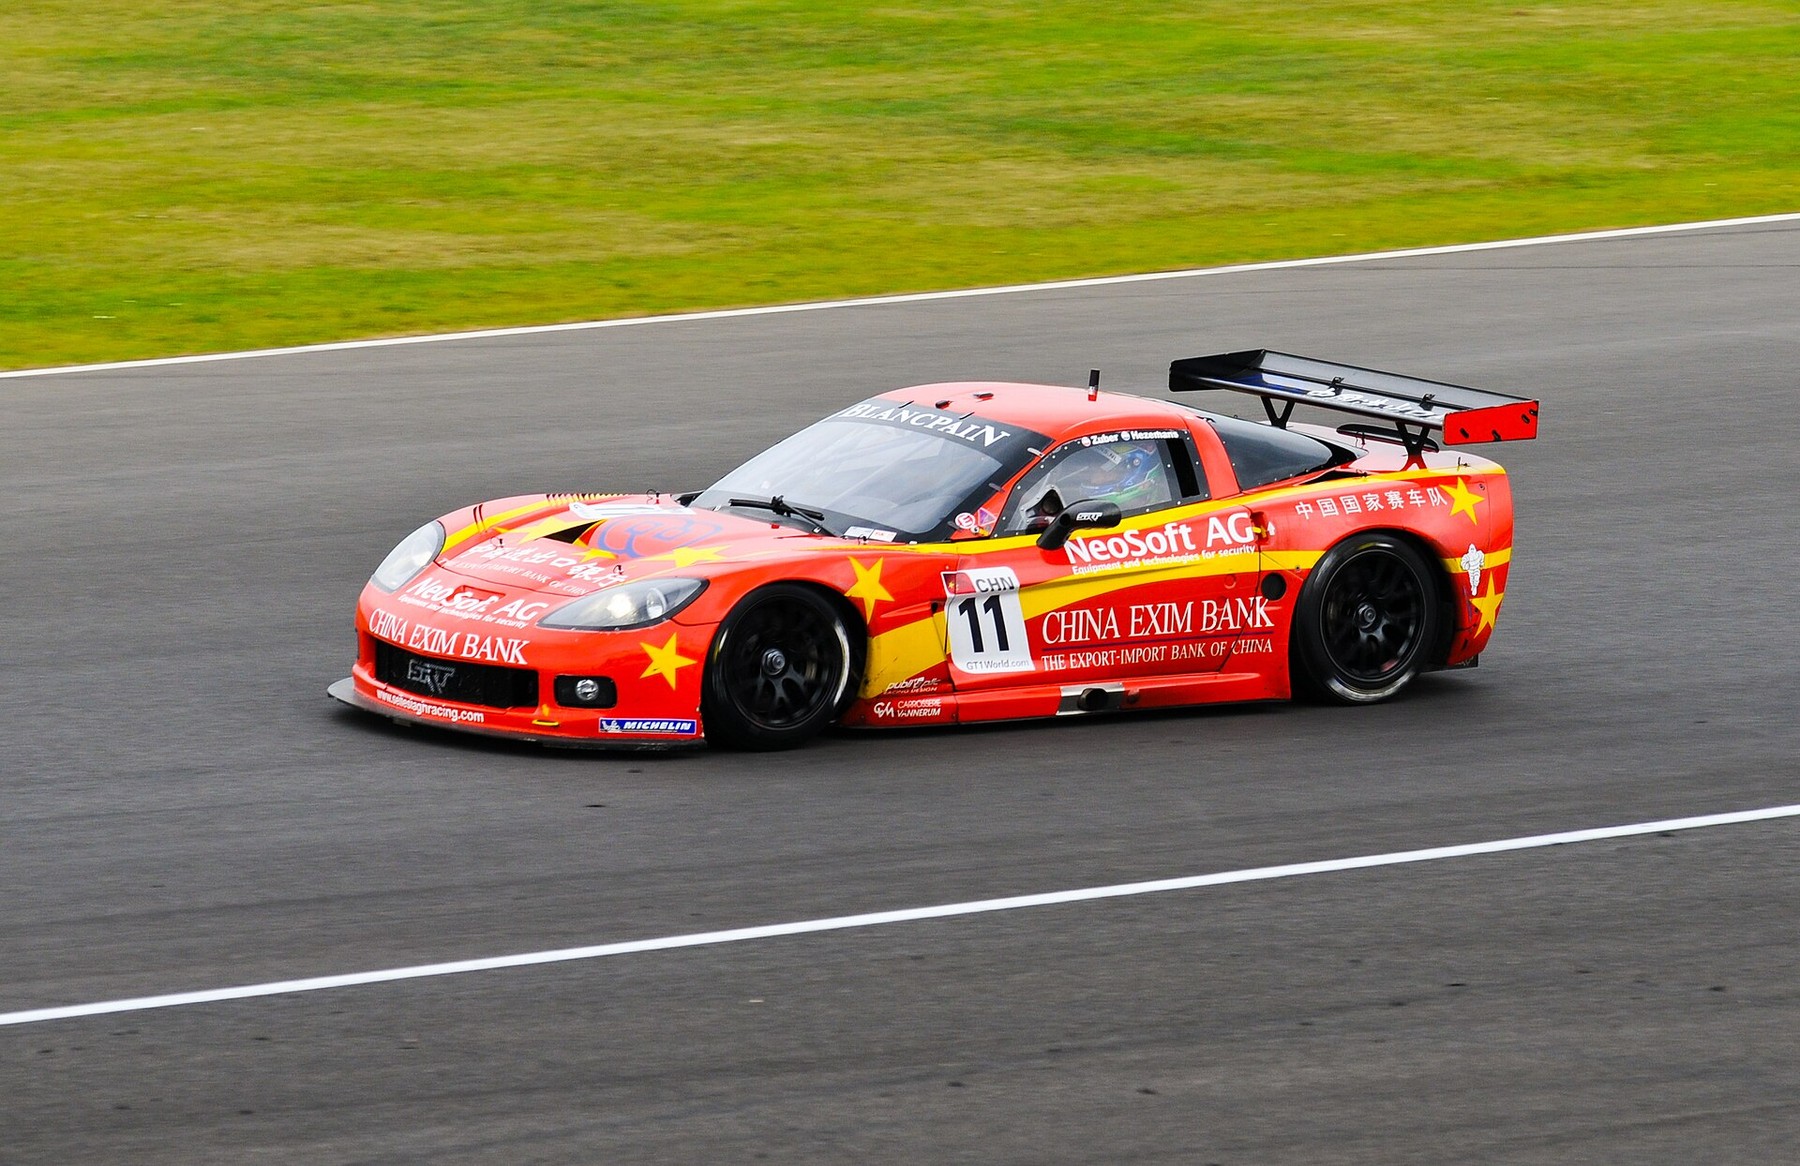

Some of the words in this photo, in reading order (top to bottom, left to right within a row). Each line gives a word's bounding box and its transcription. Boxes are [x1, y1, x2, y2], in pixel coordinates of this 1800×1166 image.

[838, 403, 1010, 447] BLANCPAIN
[1090, 433, 1119, 445] Zuber
[1130, 430, 1179, 440] Hezemans
[1294, 487, 1448, 520] 中国国家赛车队
[1063, 521, 1196, 565] NeoSoft
[1206, 512, 1256, 548] AG
[1072, 561, 1121, 576] Equipment
[1124, 558, 1141, 568] and
[1143, 552, 1200, 568] technologies
[1202, 550, 1216, 561] for
[1218, 544, 1256, 558] security
[975, 577, 1015, 593] CHN
[492, 599, 549, 620] AG
[495, 617, 529, 629] security
[958, 595, 1010, 653] 11
[1042, 606, 1120, 645] CHINA
[1129, 601, 1193, 637] EXIM
[1200, 595, 1274, 632] BANK
[368, 608, 408, 644] CHINA
[409, 623, 460, 656] EXIM
[460, 633, 530, 665] BANK
[966, 659, 1030, 671] GT1World.com
[1041, 653, 1067, 671] THE
[1069, 645, 1167, 668] EXPORT-IMPORT
[1171, 642, 1206, 660] BANK
[1210, 641, 1227, 655] OF
[1231, 638, 1273, 655] CHINA
[623, 721, 692, 731] MICHELIN
